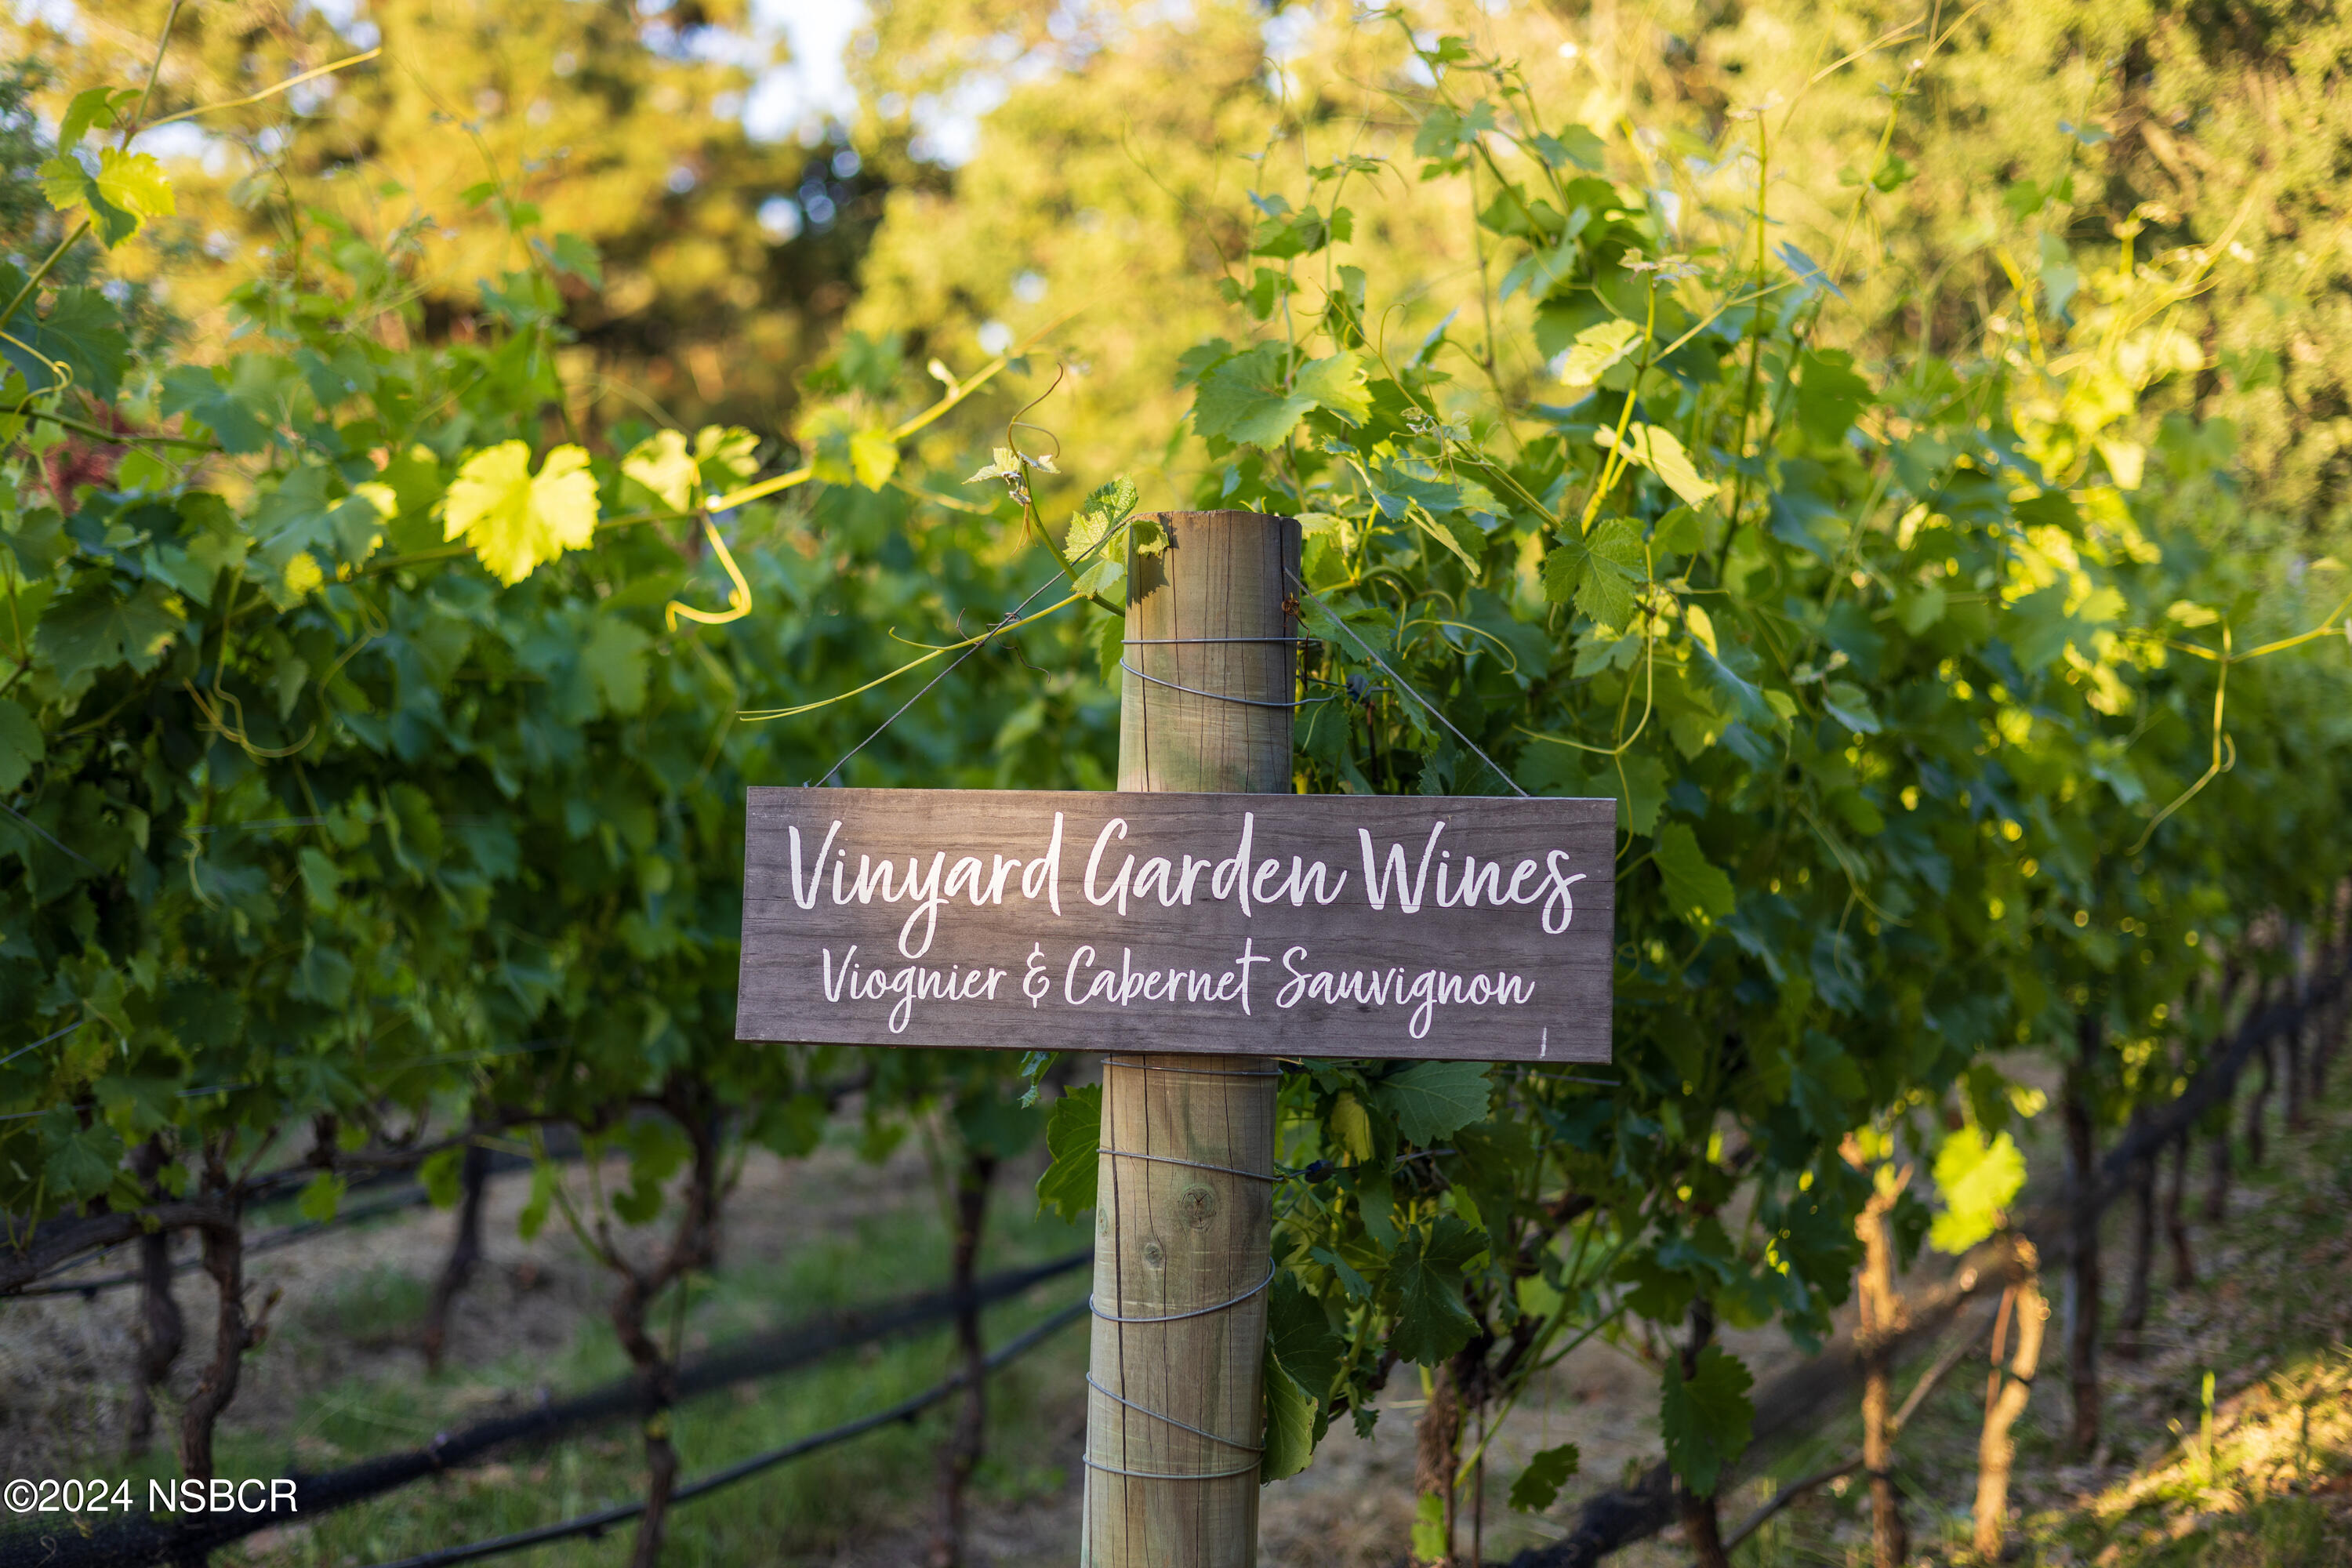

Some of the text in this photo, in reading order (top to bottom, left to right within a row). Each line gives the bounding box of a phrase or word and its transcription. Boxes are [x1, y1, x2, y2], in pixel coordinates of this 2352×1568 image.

[788, 811, 1588, 960] Vinyard Garden Wines
[822, 937, 1536, 1040] Viognier & Cabernet Sauvignon
